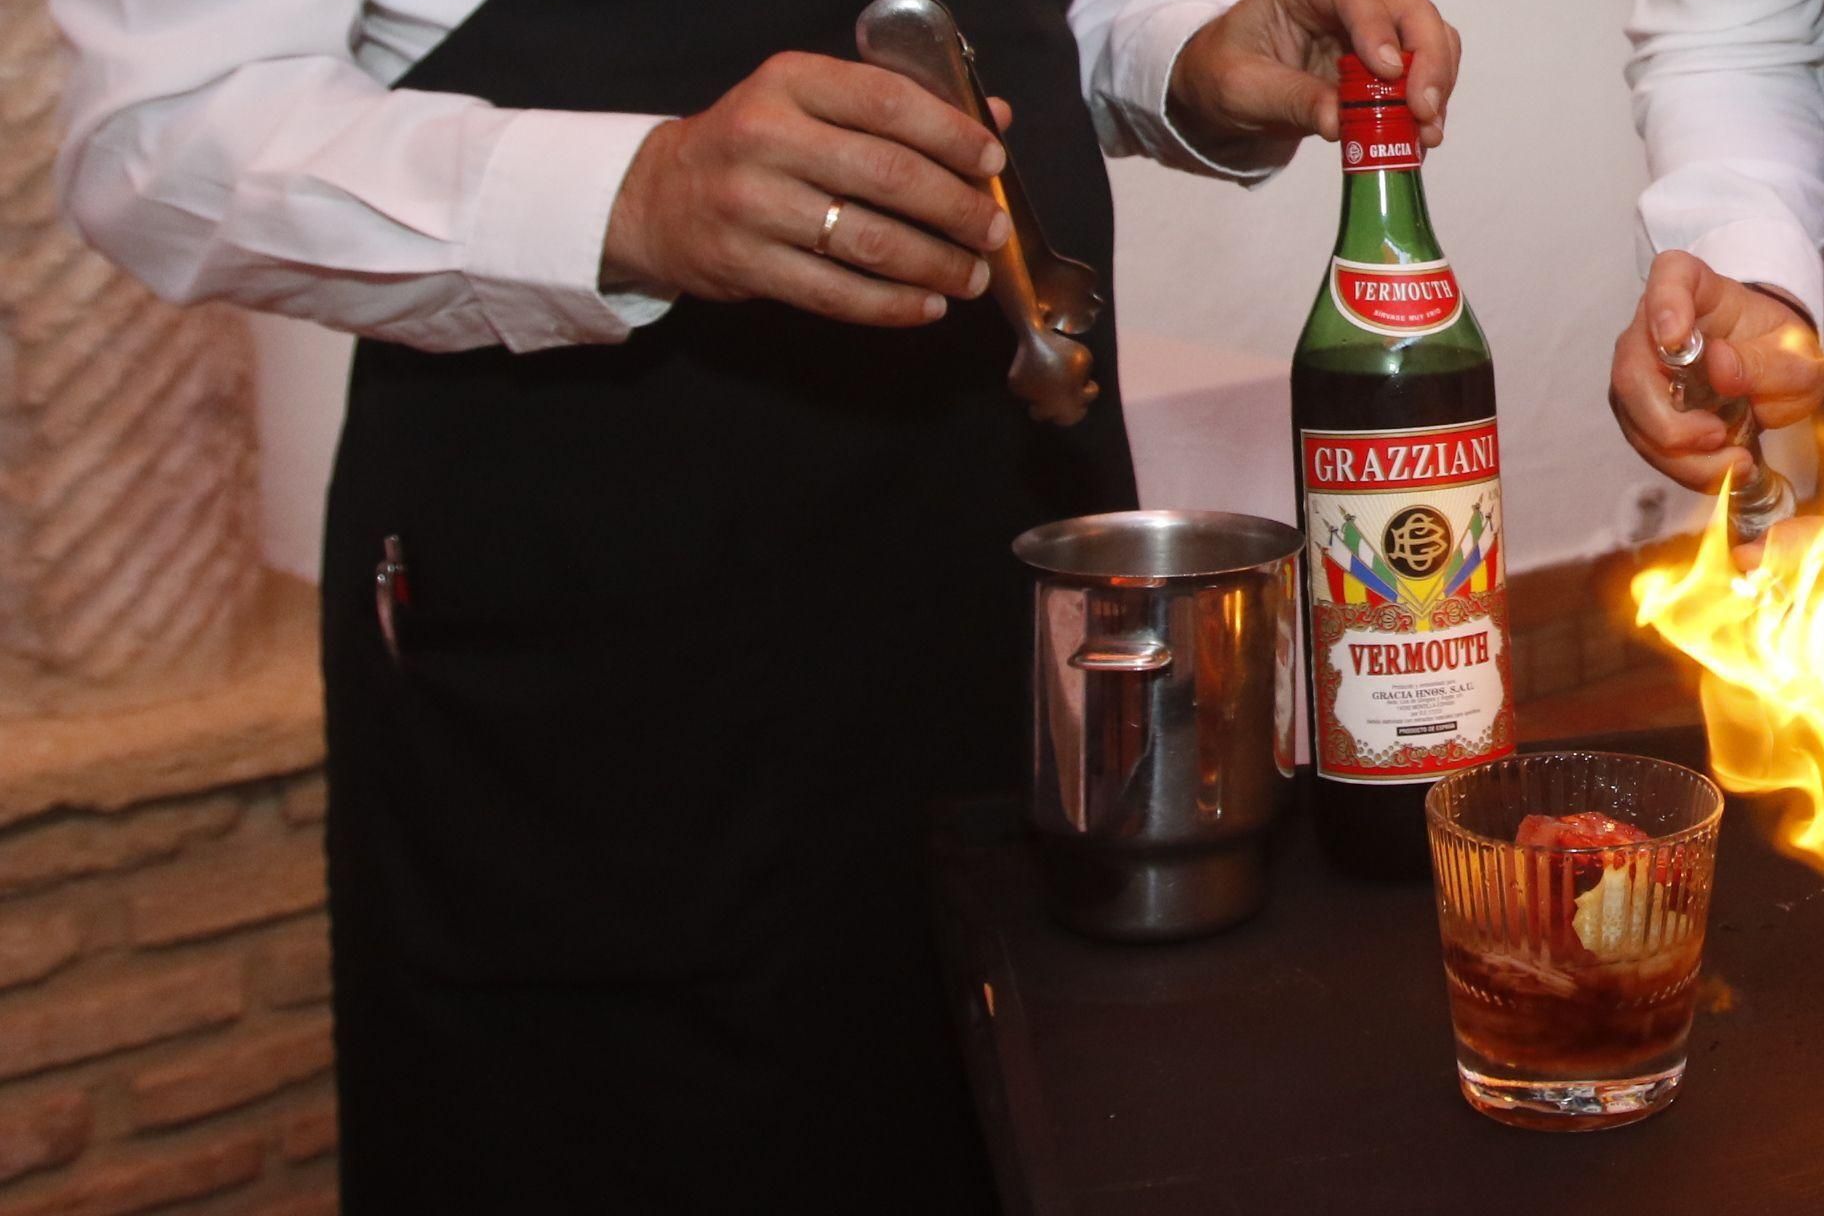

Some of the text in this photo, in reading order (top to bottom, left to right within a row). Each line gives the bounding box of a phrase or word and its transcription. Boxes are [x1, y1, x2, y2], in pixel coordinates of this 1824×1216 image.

[1369, 143, 1412, 158] GRACIA
[1354, 280, 1454, 301] VERMOUTH
[1314, 434, 1496, 483] GRAZZIANI
[1349, 631, 1489, 676] VERMOUTH
[1372, 690, 1413, 700] GRACIA
[1428, 725, 1435, 733] DE
